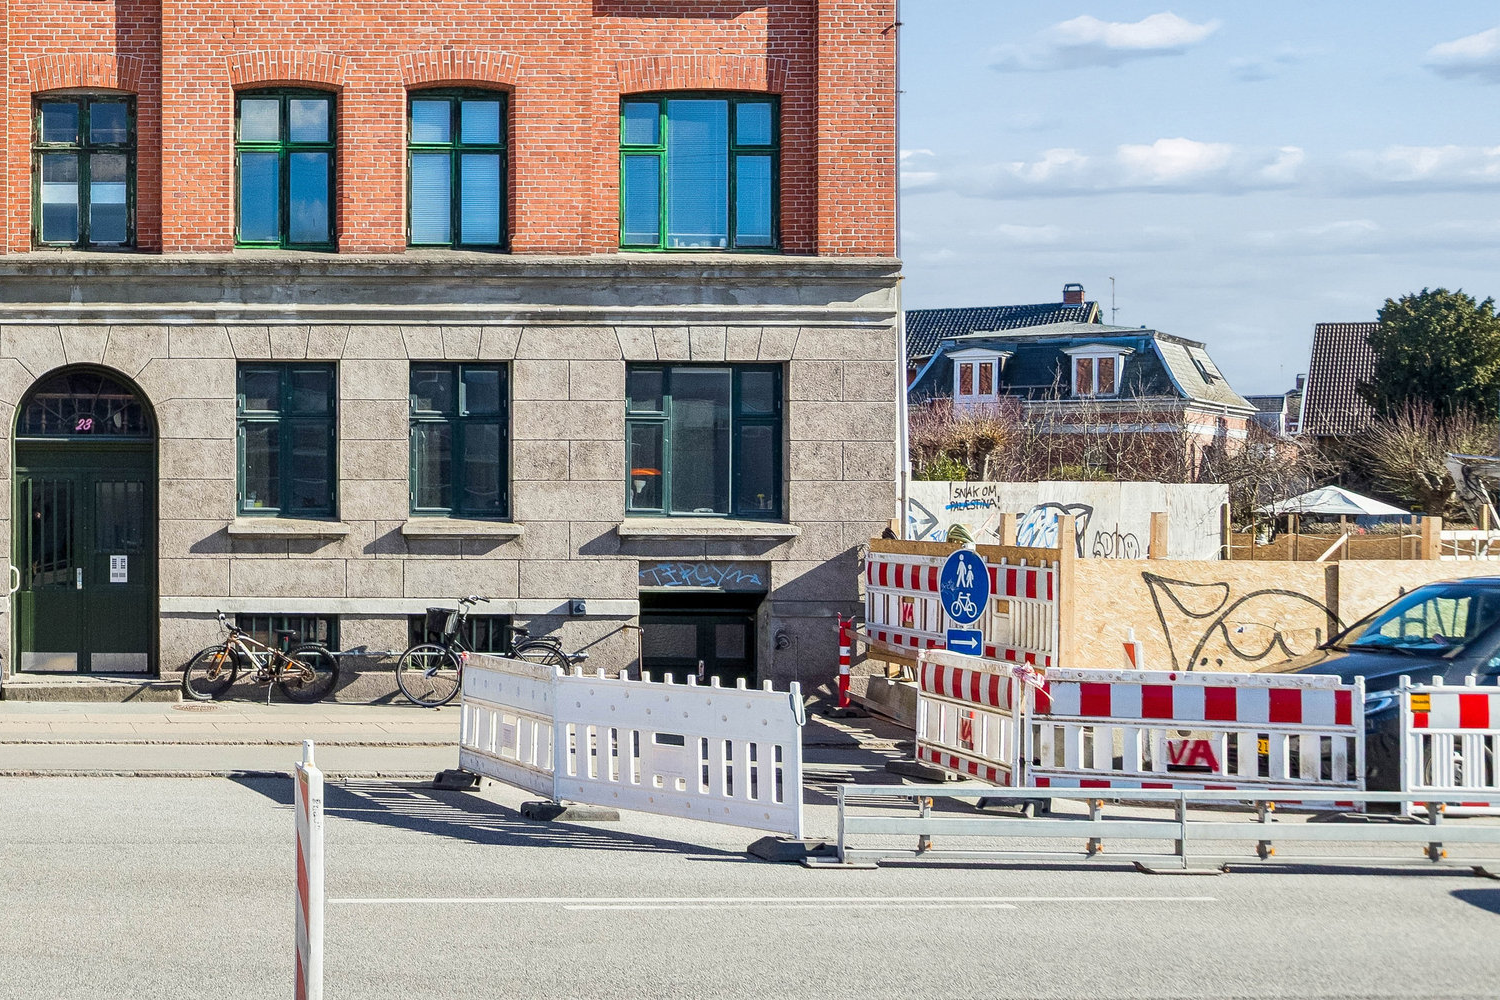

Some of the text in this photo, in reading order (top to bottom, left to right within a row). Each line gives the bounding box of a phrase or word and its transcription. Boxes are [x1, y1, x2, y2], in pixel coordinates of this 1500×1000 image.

[75, 418, 93, 430] 23
[954, 485, 997, 498] SNAK OM
[1167, 739, 1220, 772] VA
